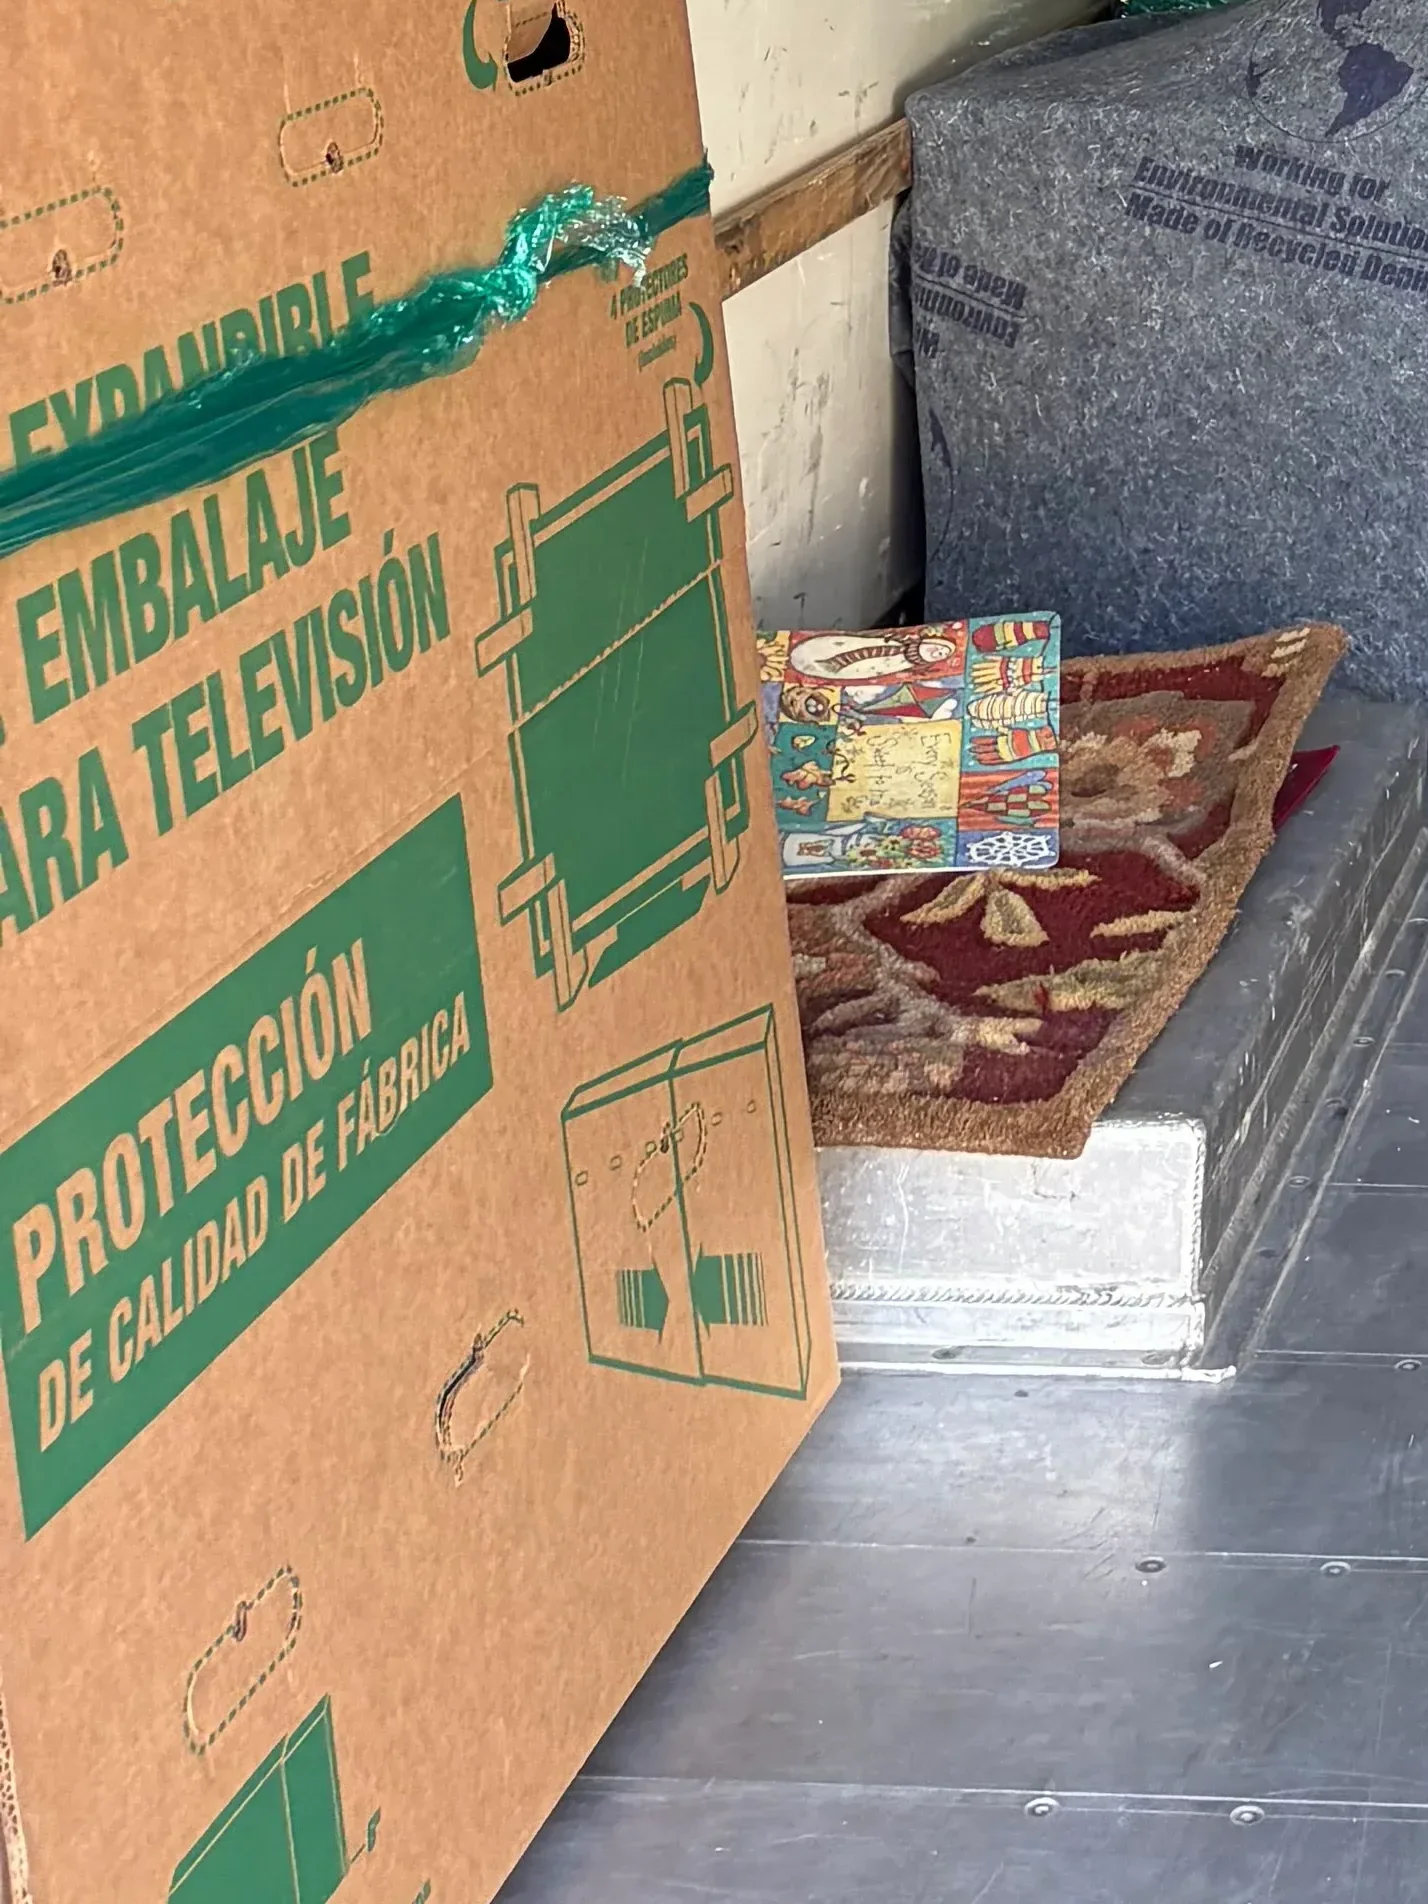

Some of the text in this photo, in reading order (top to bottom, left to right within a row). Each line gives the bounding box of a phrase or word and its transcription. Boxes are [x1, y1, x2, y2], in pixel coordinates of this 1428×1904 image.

[1124, 193, 1200, 235] Made
[1203, 218, 1233, 242] of
[1234, 223, 1361, 278] Recycled
[1134, 155, 1331, 230] Environmental
[1235, 144, 1391, 204] Working for
[17, 430, 352, 725] EMBALAJE
[131, 528, 451, 837] TELEVISIÓN
[12, 937, 373, 1335] PROTECCIÓN
[39, 990, 471, 1453] DE CALIDAD DE FÁBRICA
